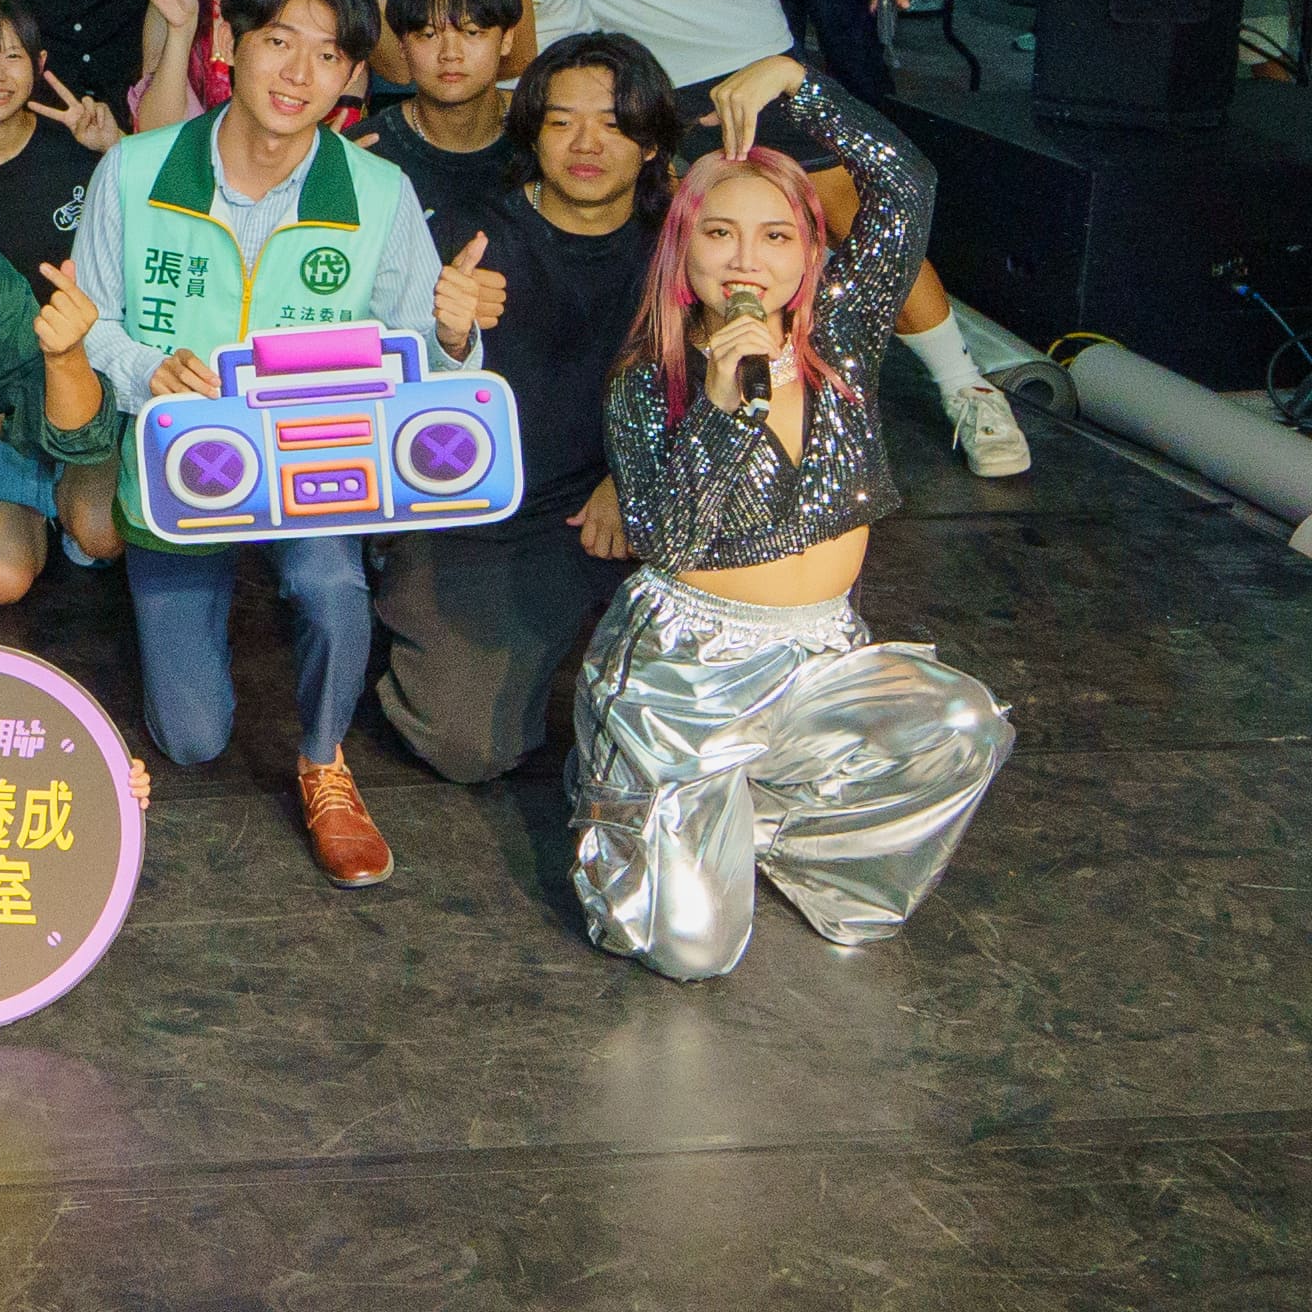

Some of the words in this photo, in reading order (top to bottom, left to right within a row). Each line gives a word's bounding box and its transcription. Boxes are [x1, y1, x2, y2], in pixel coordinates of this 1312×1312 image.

[184, 255, 210, 299] 專員
[138, 247, 185, 356] 張玉
[279, 305, 354, 323] 立法委員
